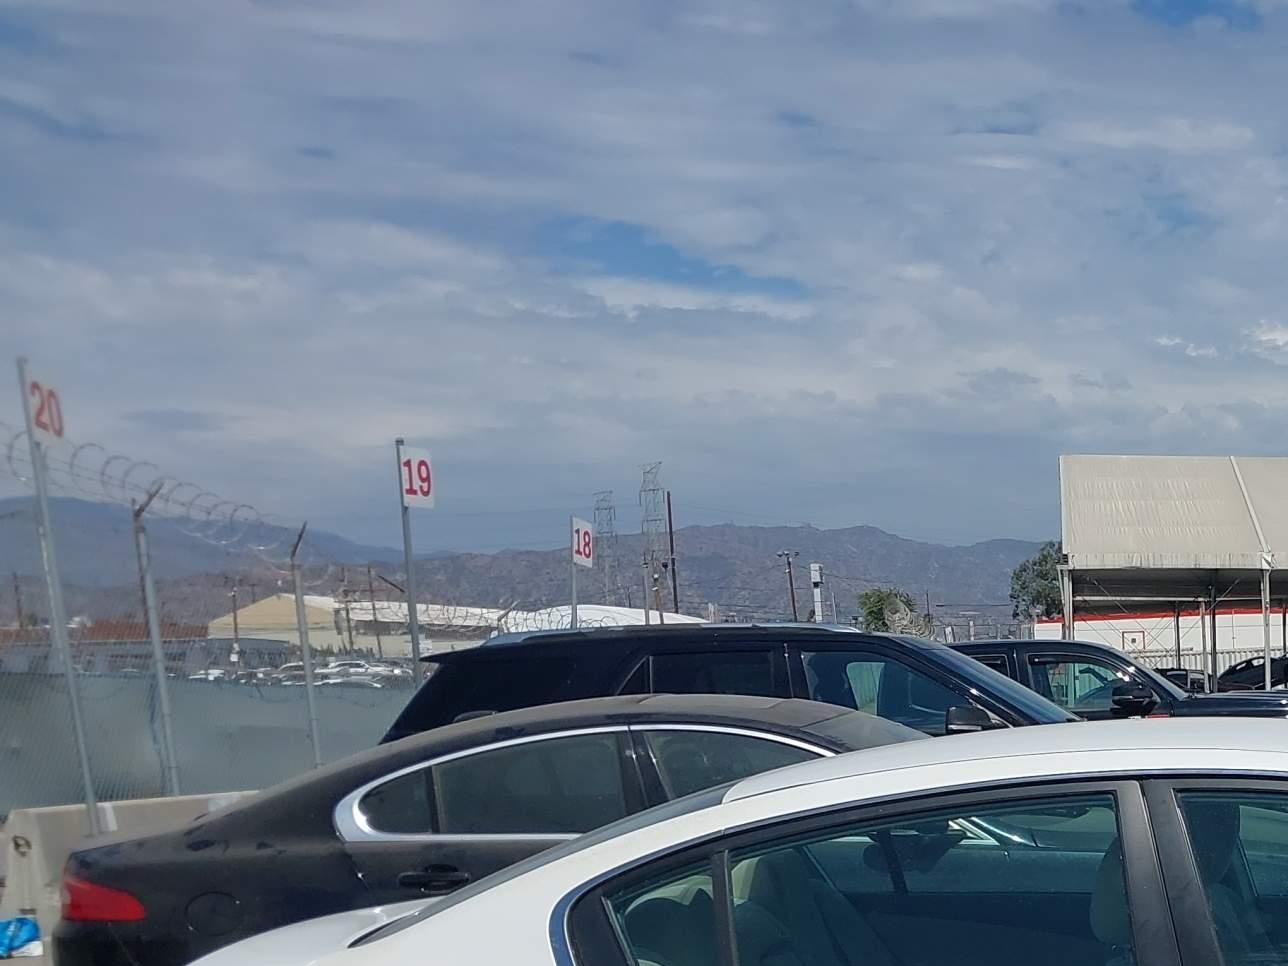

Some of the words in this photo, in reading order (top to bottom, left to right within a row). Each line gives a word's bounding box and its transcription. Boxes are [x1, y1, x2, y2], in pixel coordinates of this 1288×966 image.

[31, 381, 64, 438] 20
[403, 459, 431, 497] 19
[574, 528, 592, 559] 18
